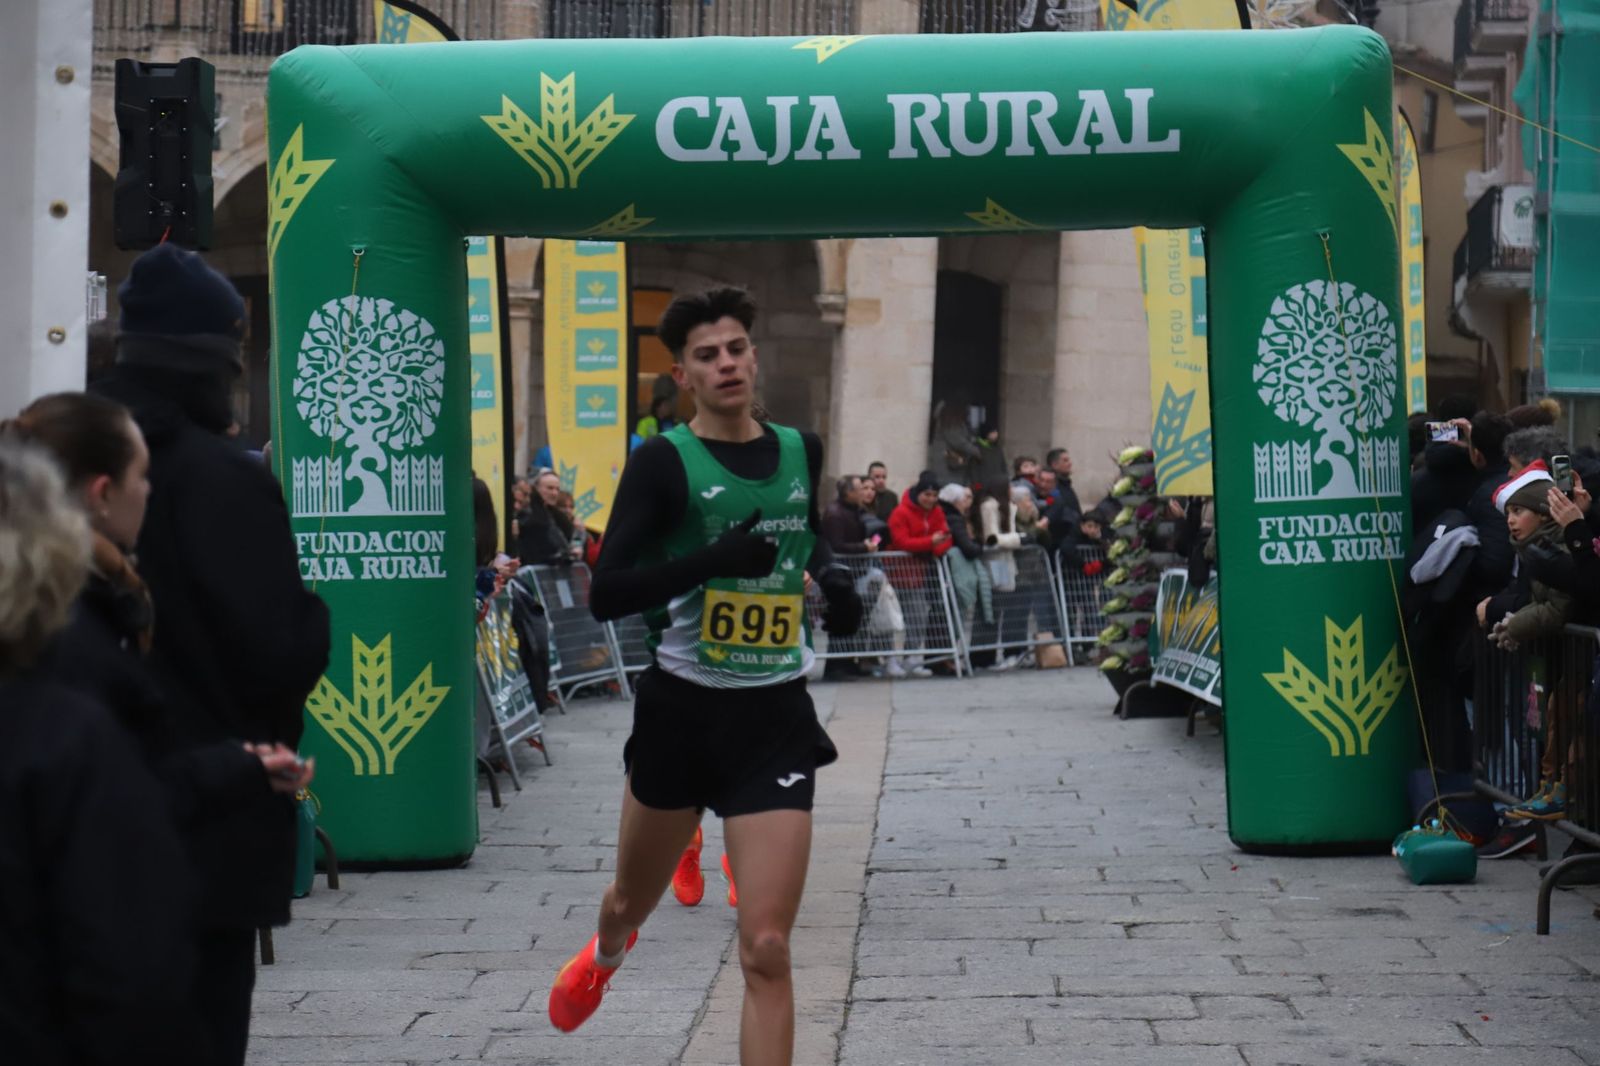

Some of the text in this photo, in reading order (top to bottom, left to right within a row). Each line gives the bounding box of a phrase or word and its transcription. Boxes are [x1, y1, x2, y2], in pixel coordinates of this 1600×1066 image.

[655, 87, 1181, 165] CAJA RURAL
[1258, 512, 1403, 540] FUNDACION
[295, 530, 446, 554] FUNDACION
[1259, 536, 1405, 566] CAJA RURAL
[361, 555, 447, 580] RURAL
[710, 601, 791, 645] 695
